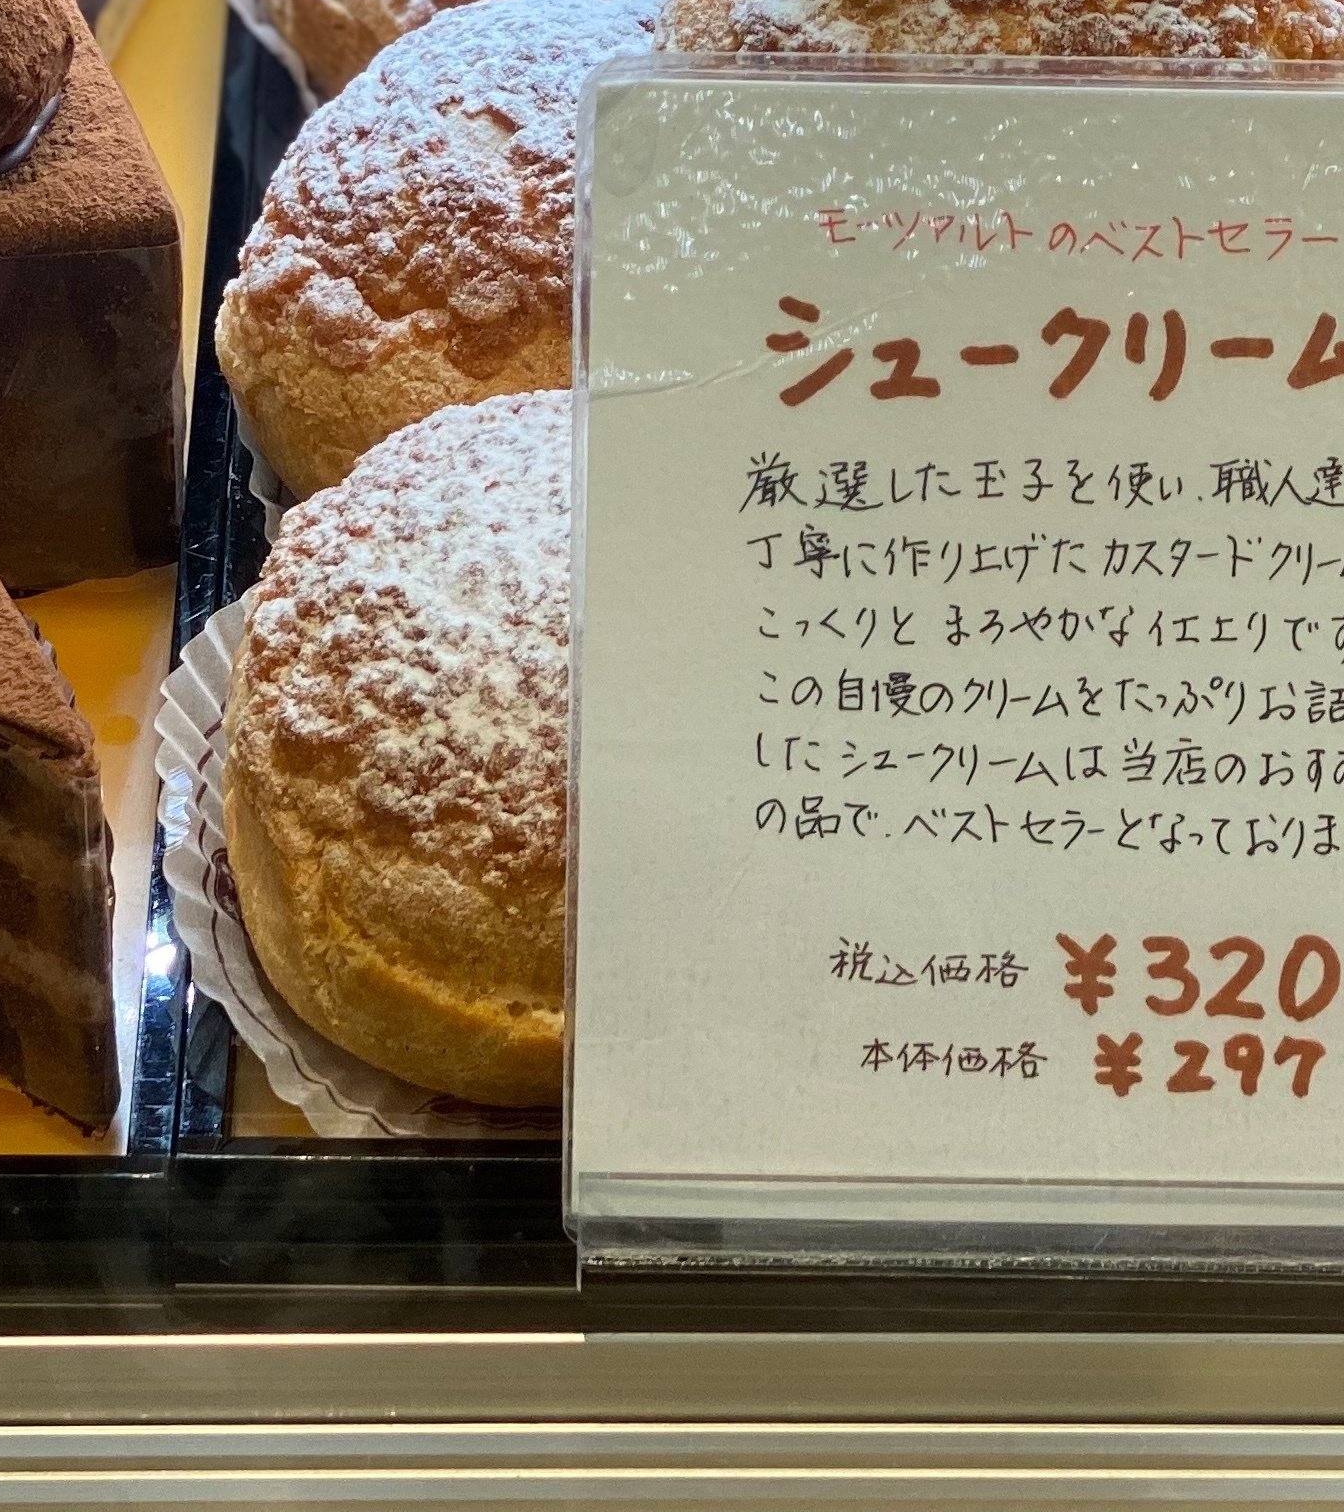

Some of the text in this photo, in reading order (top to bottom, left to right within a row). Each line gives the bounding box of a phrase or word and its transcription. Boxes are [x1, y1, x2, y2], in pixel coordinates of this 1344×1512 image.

[820, 209, 1338, 259] モーツァルトのベストセラー
[829, 934, 1342, 1022] 税込価格 ¥320
[861, 1033, 1325, 1097] 本体価格 ¥297
